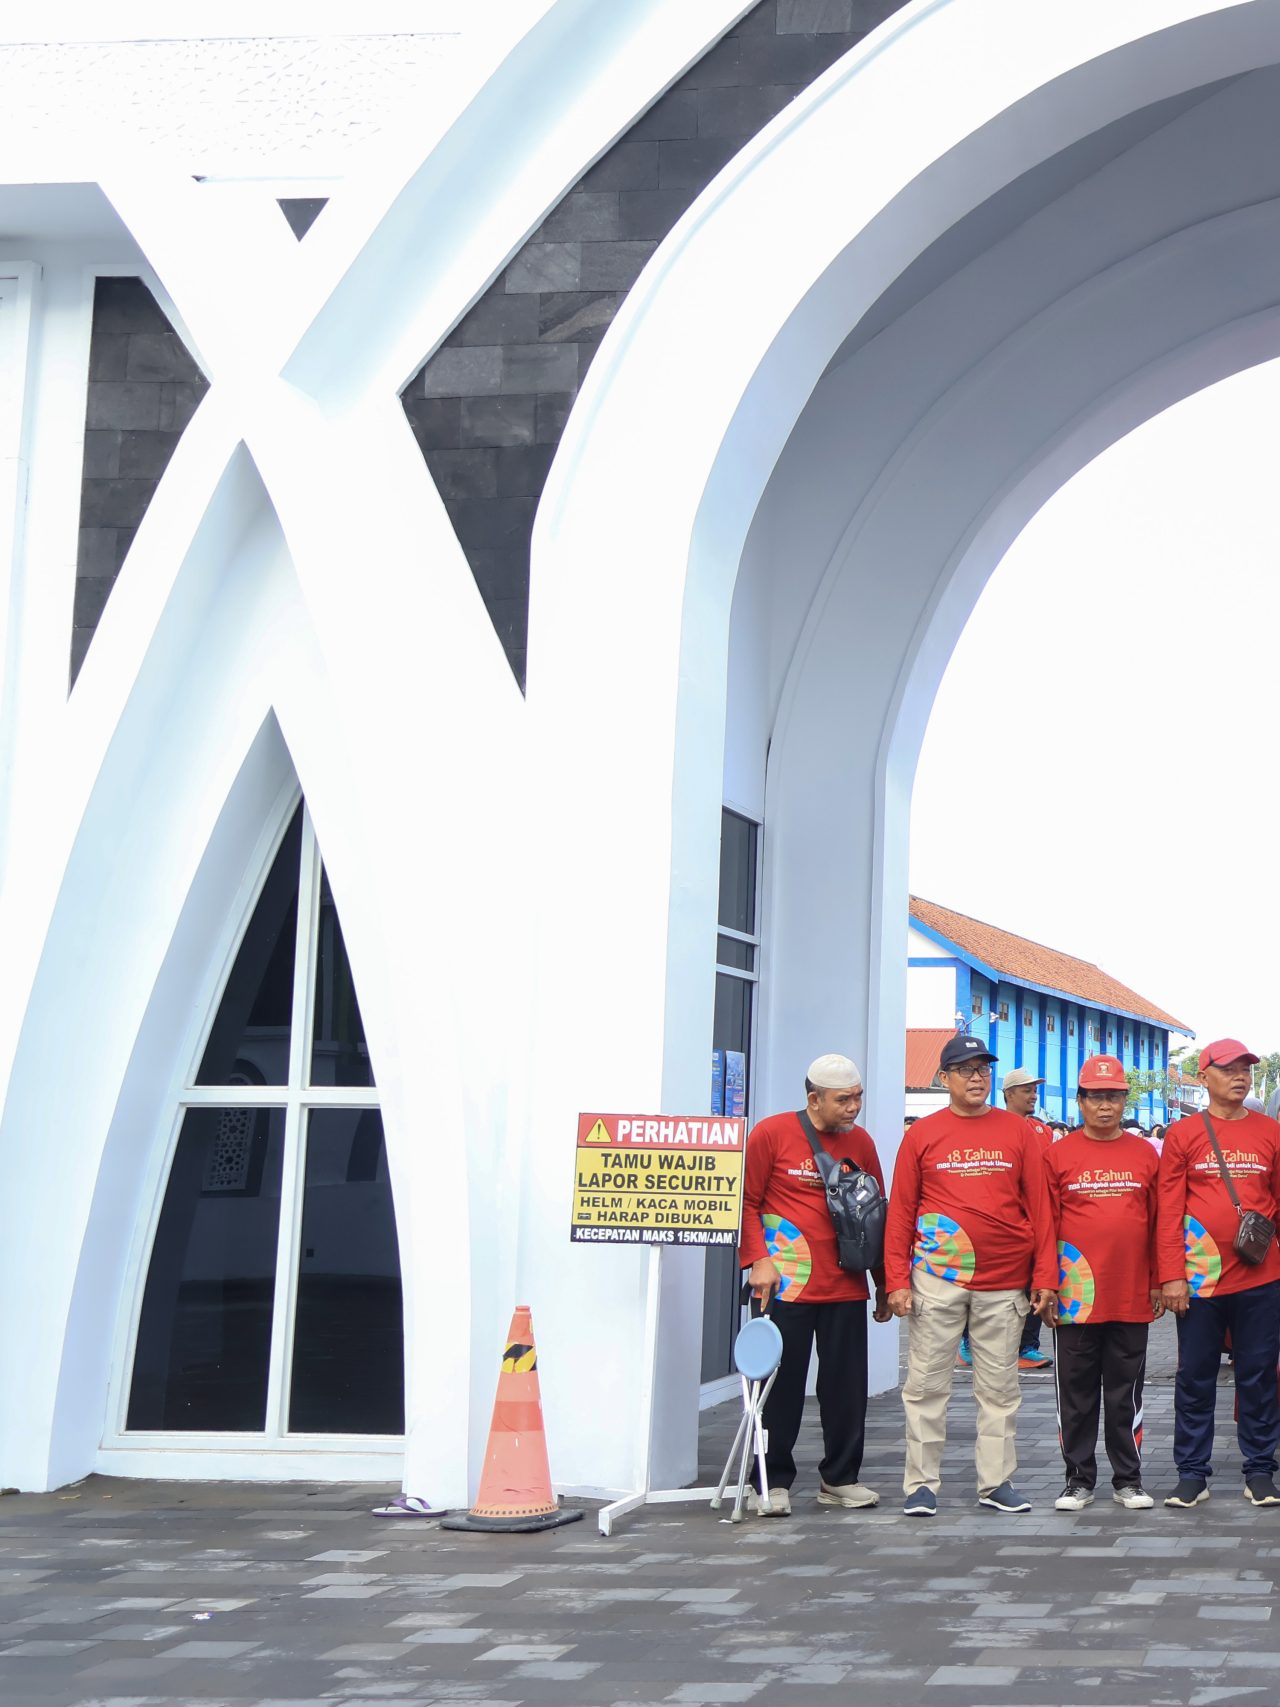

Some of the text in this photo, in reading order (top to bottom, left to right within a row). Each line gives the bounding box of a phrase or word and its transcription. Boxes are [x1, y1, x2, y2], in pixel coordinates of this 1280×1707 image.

[617, 1119, 739, 1145] PERHATIAN
[601, 1152, 716, 1171] TAMU WAJIB
[947, 1147, 1003, 1162] 18 Tahun
[1221, 1149, 1259, 1163] Tahun
[800, 1158, 813, 1170] 18
[578, 1172, 737, 1192] LAPOR SECURITY
[1077, 1169, 1133, 1183] 18 Tahun
[580, 1196, 623, 1208] HELM
[636, 1198, 679, 1210] KACA
[684, 1199, 733, 1212] MOBIL
[597, 1210, 714, 1225] HARAP DIBUKA
[575, 1227, 733, 1244] KECEPATAN MAKS 15KM/JAM
